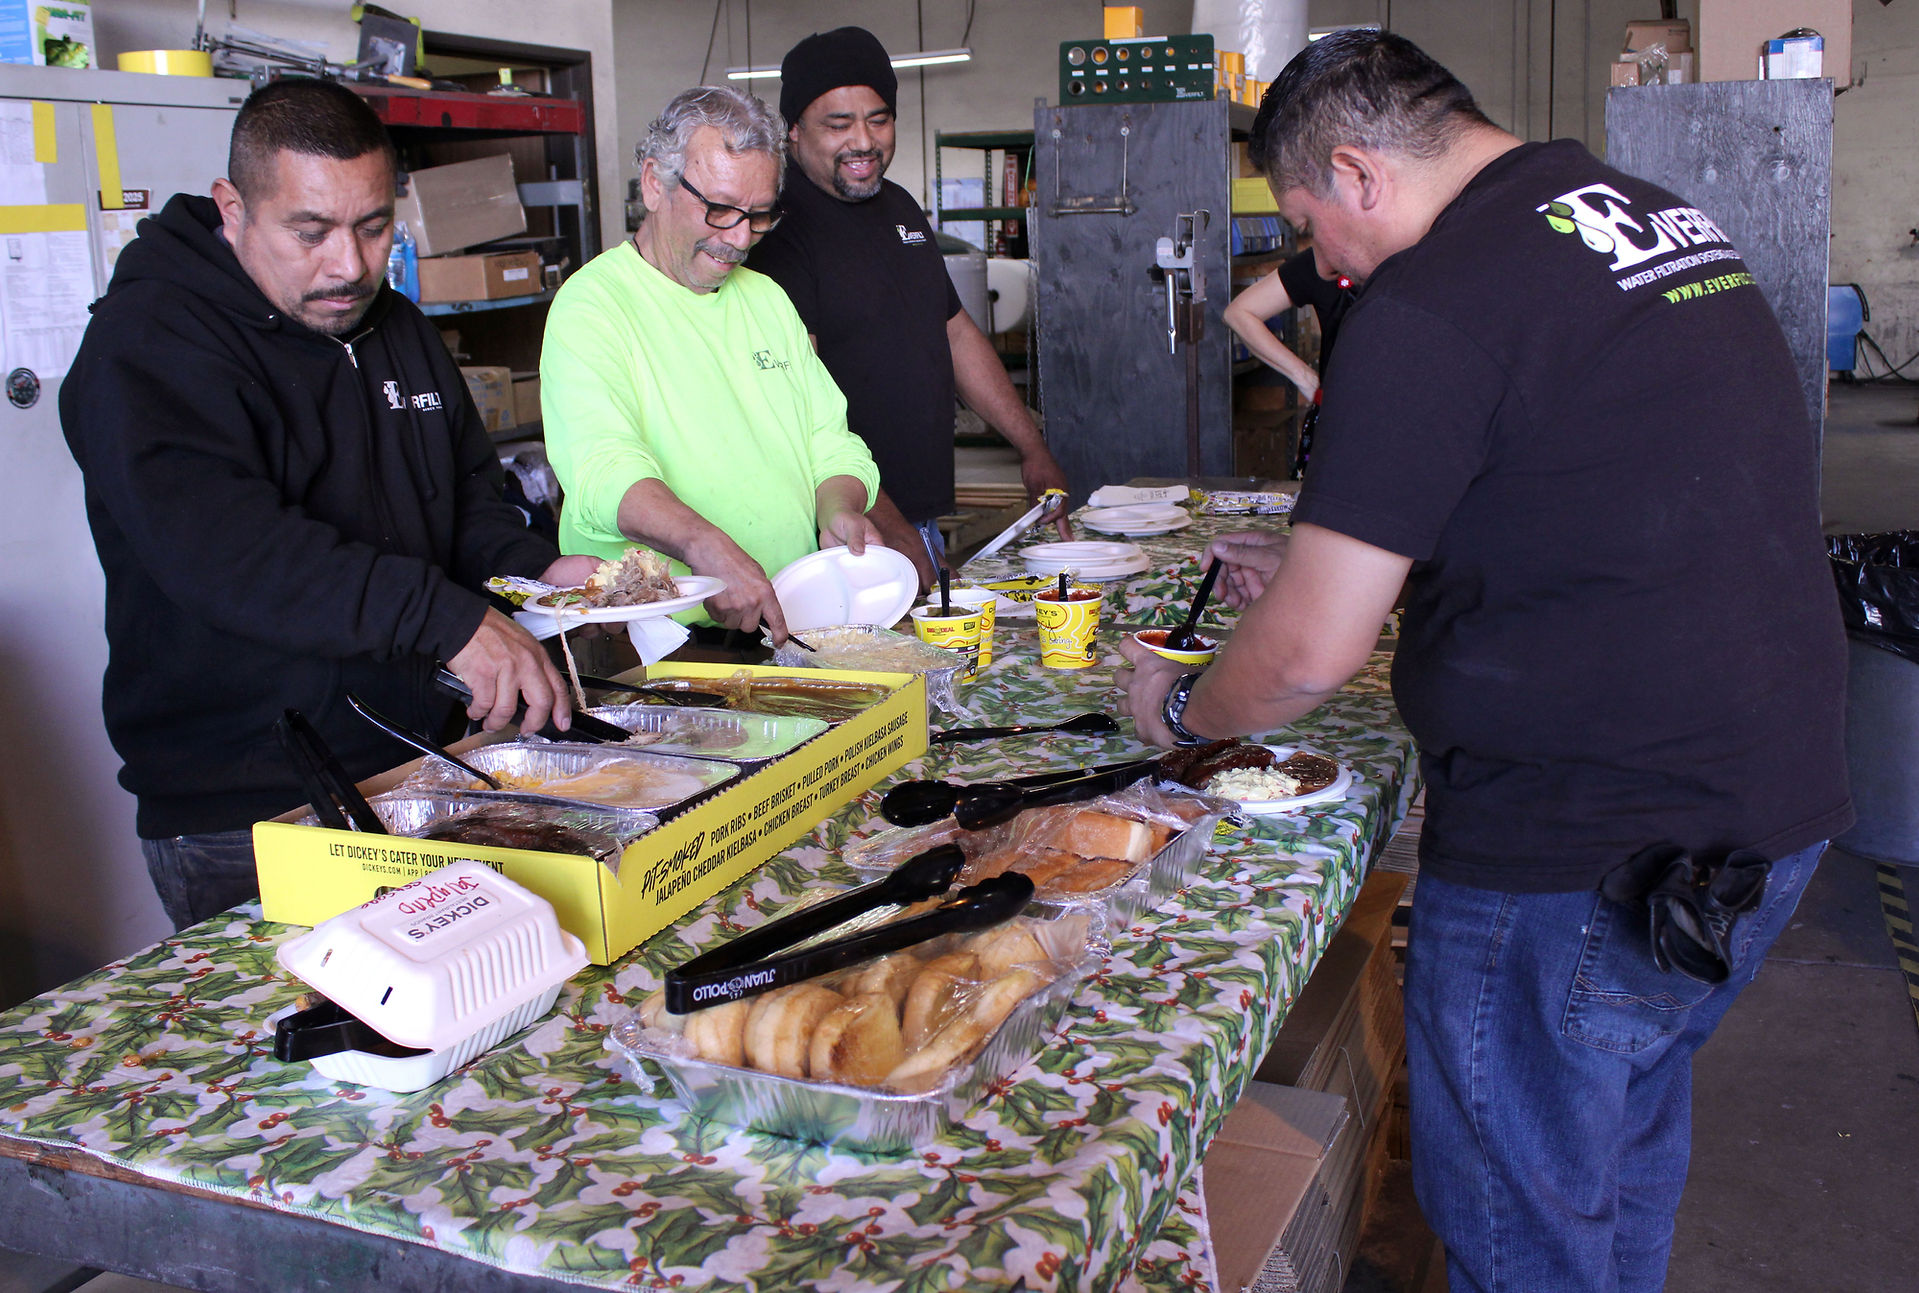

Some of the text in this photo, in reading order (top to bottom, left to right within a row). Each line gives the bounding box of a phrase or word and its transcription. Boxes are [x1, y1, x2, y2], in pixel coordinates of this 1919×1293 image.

[1616, 269, 1657, 292] WATER
[1653, 254, 1702, 279] FILTRATION
[710, 825, 730, 847] PORK
[730, 812, 747, 835] RIBS
[753, 797, 770, 820] BEEF
[770, 782, 796, 810] BRISKET
[802, 765, 824, 790] PULLED
[824, 755, 840, 776] PORK
[844, 740, 863, 763] POLISH
[863, 725, 887, 751] KIELBASA
[887, 711, 908, 736] SAUSAGE
[655, 734, 904, 906] JALAPEÑO CHEDDAR KIELBASA CHICKEN BREAST TURKEY BREAST CHICKEN WINGS
[329, 843, 345, 857] LET
[347, 845, 388, 862] DICKEY'S
[389, 850, 418, 866] CATER
[420, 853, 445, 869] YOUR
[362, 863, 401, 875] DICKEYS.COM
[407, 868, 419, 877] APP
[407, 896, 491, 940] DICKEY'S
[693, 968, 776, 1002] JUAN POLLO
